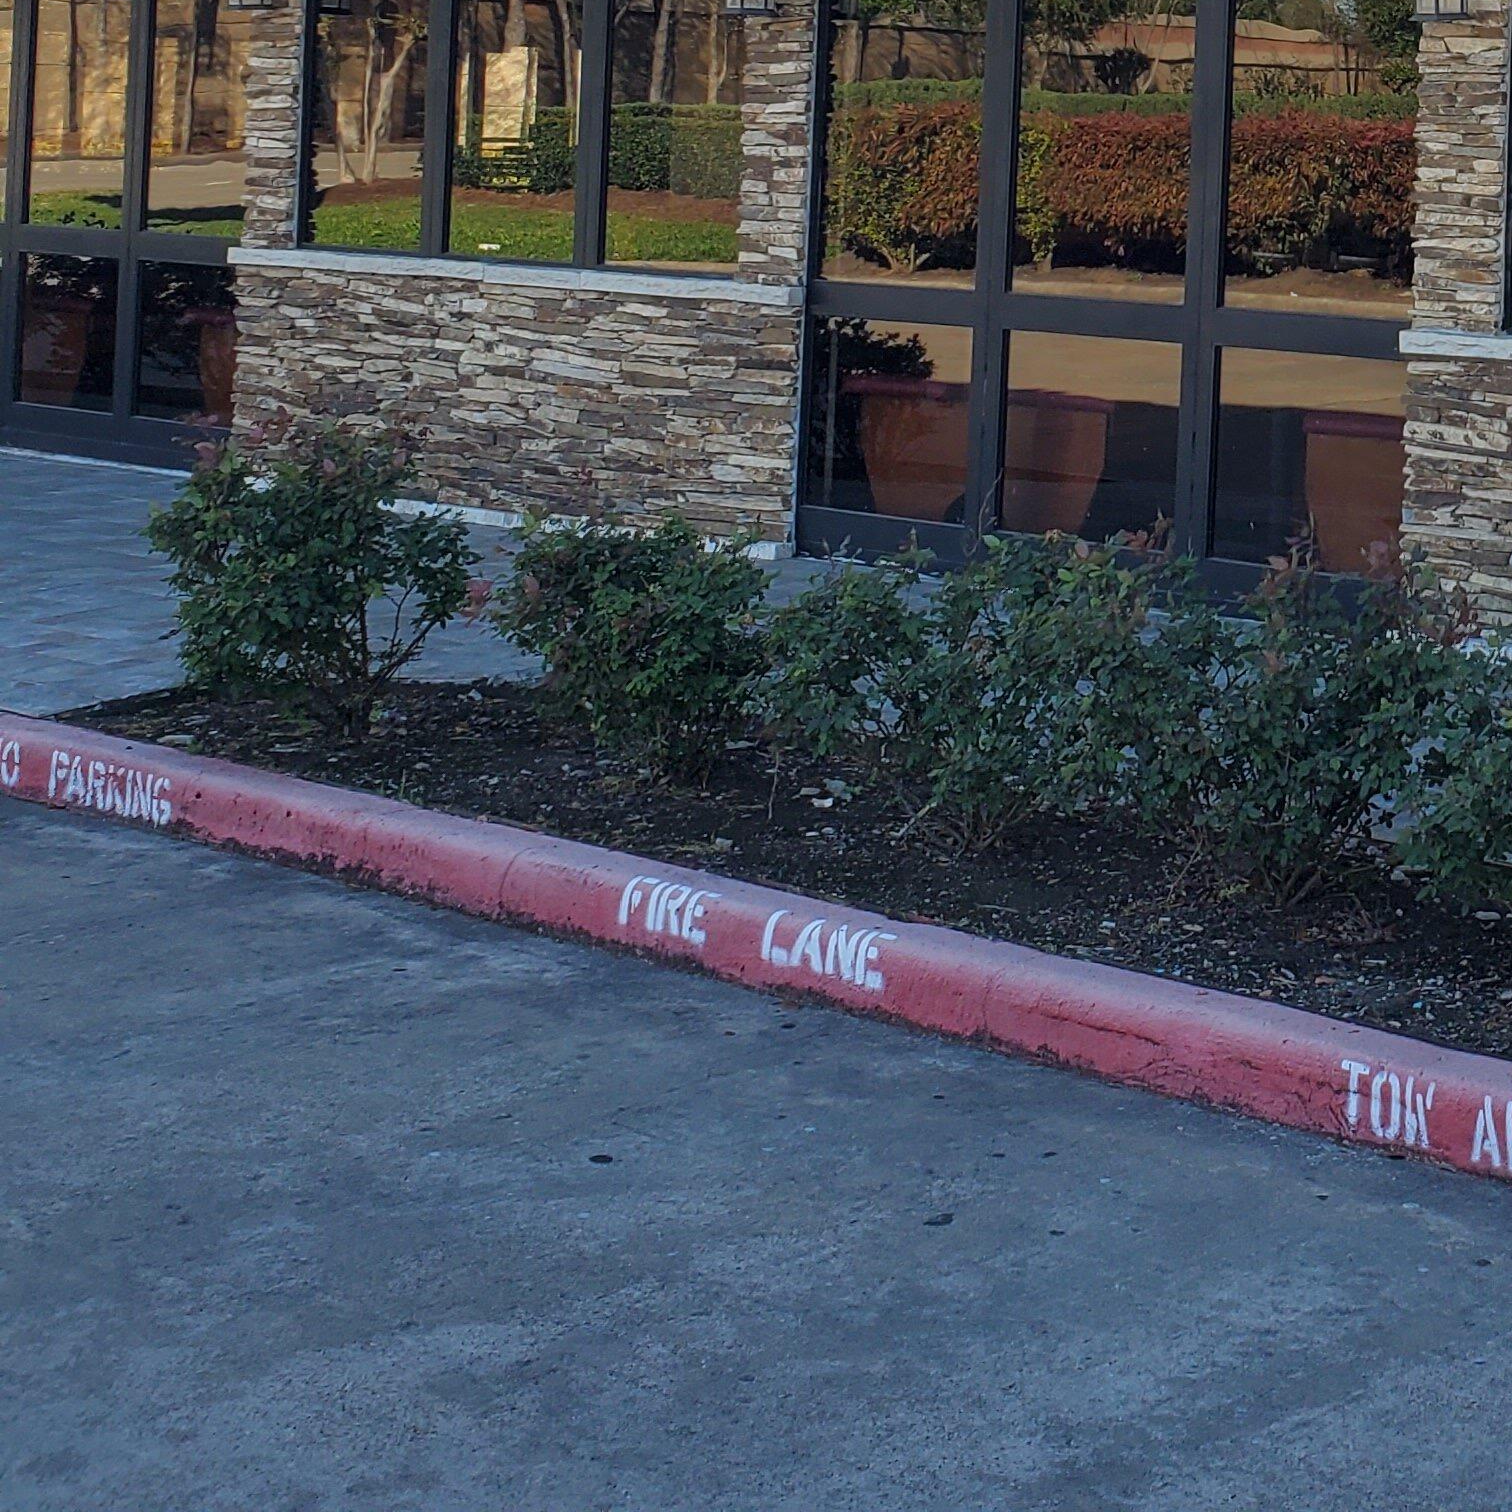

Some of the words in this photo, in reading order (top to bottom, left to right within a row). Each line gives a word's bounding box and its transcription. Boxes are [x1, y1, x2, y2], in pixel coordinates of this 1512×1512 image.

[0, 740, 20, 787] O
[48, 750, 172, 828] PARKING
[618, 875, 722, 945] FIRE
[761, 909, 898, 990] LANE
[1341, 1059, 1436, 1149] TOW
